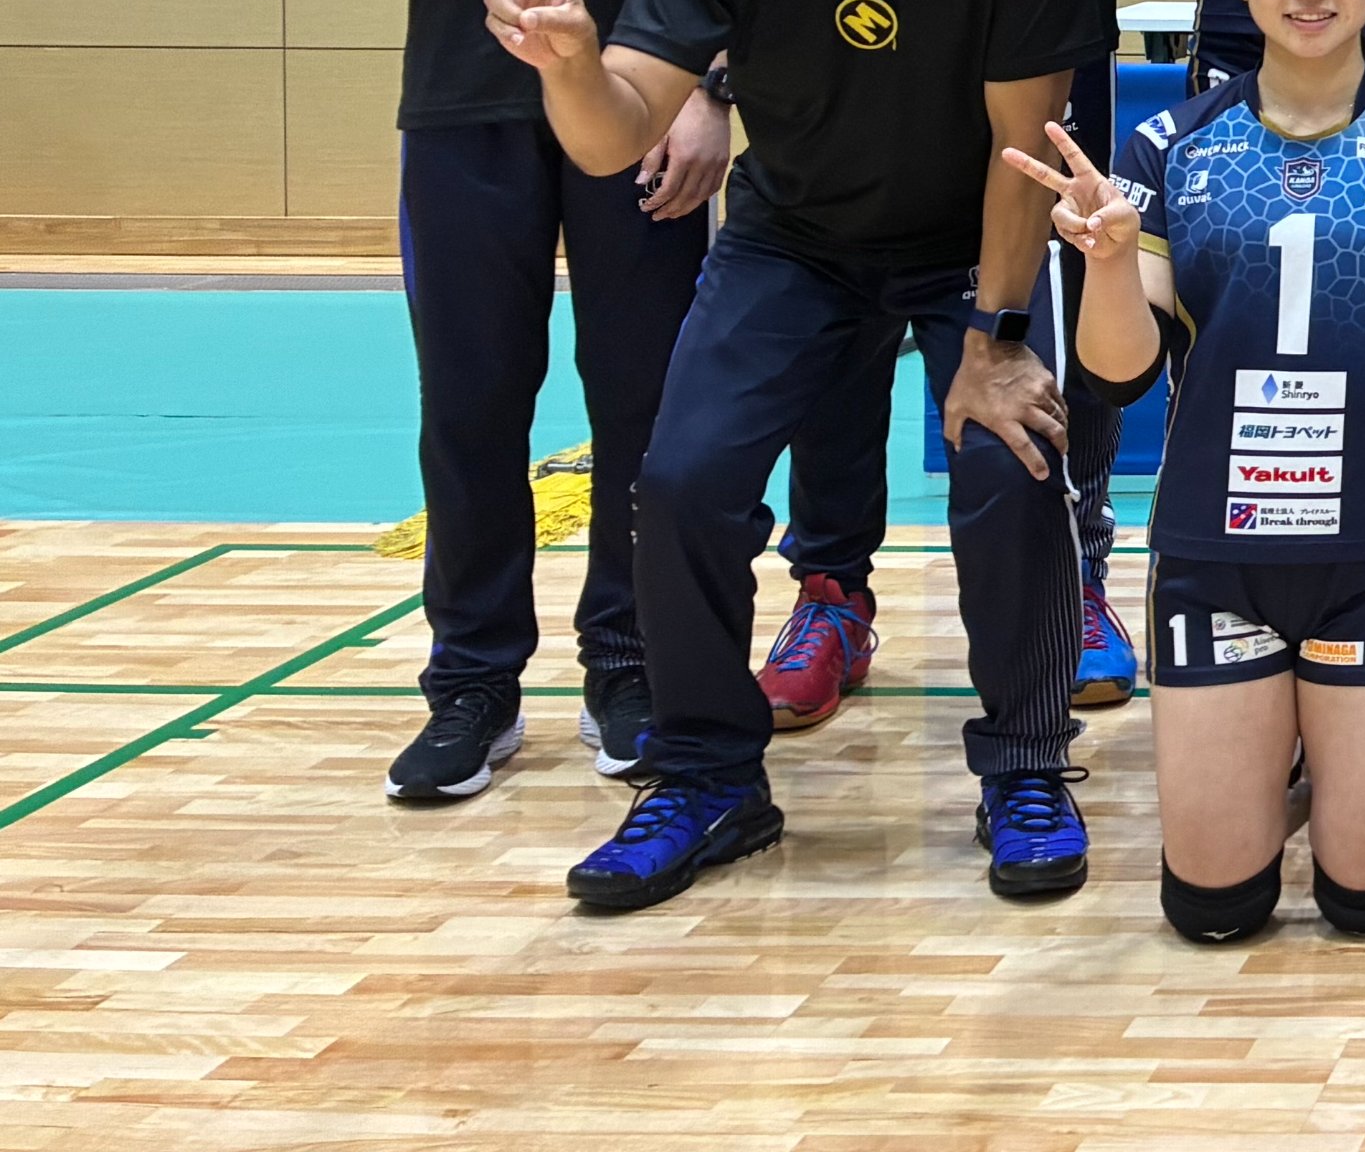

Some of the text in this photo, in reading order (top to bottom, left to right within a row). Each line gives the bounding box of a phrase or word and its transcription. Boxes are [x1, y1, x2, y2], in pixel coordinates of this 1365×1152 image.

[1268, 213, 1316, 355] 1
[1281, 389, 1319, 400] Shinryo
[1238, 425, 1338, 440] 福岡トヨペット
[1237, 466, 1335, 484] Yakult
[1260, 516, 1338, 528] Break through
[1168, 614, 1188, 666] 1
